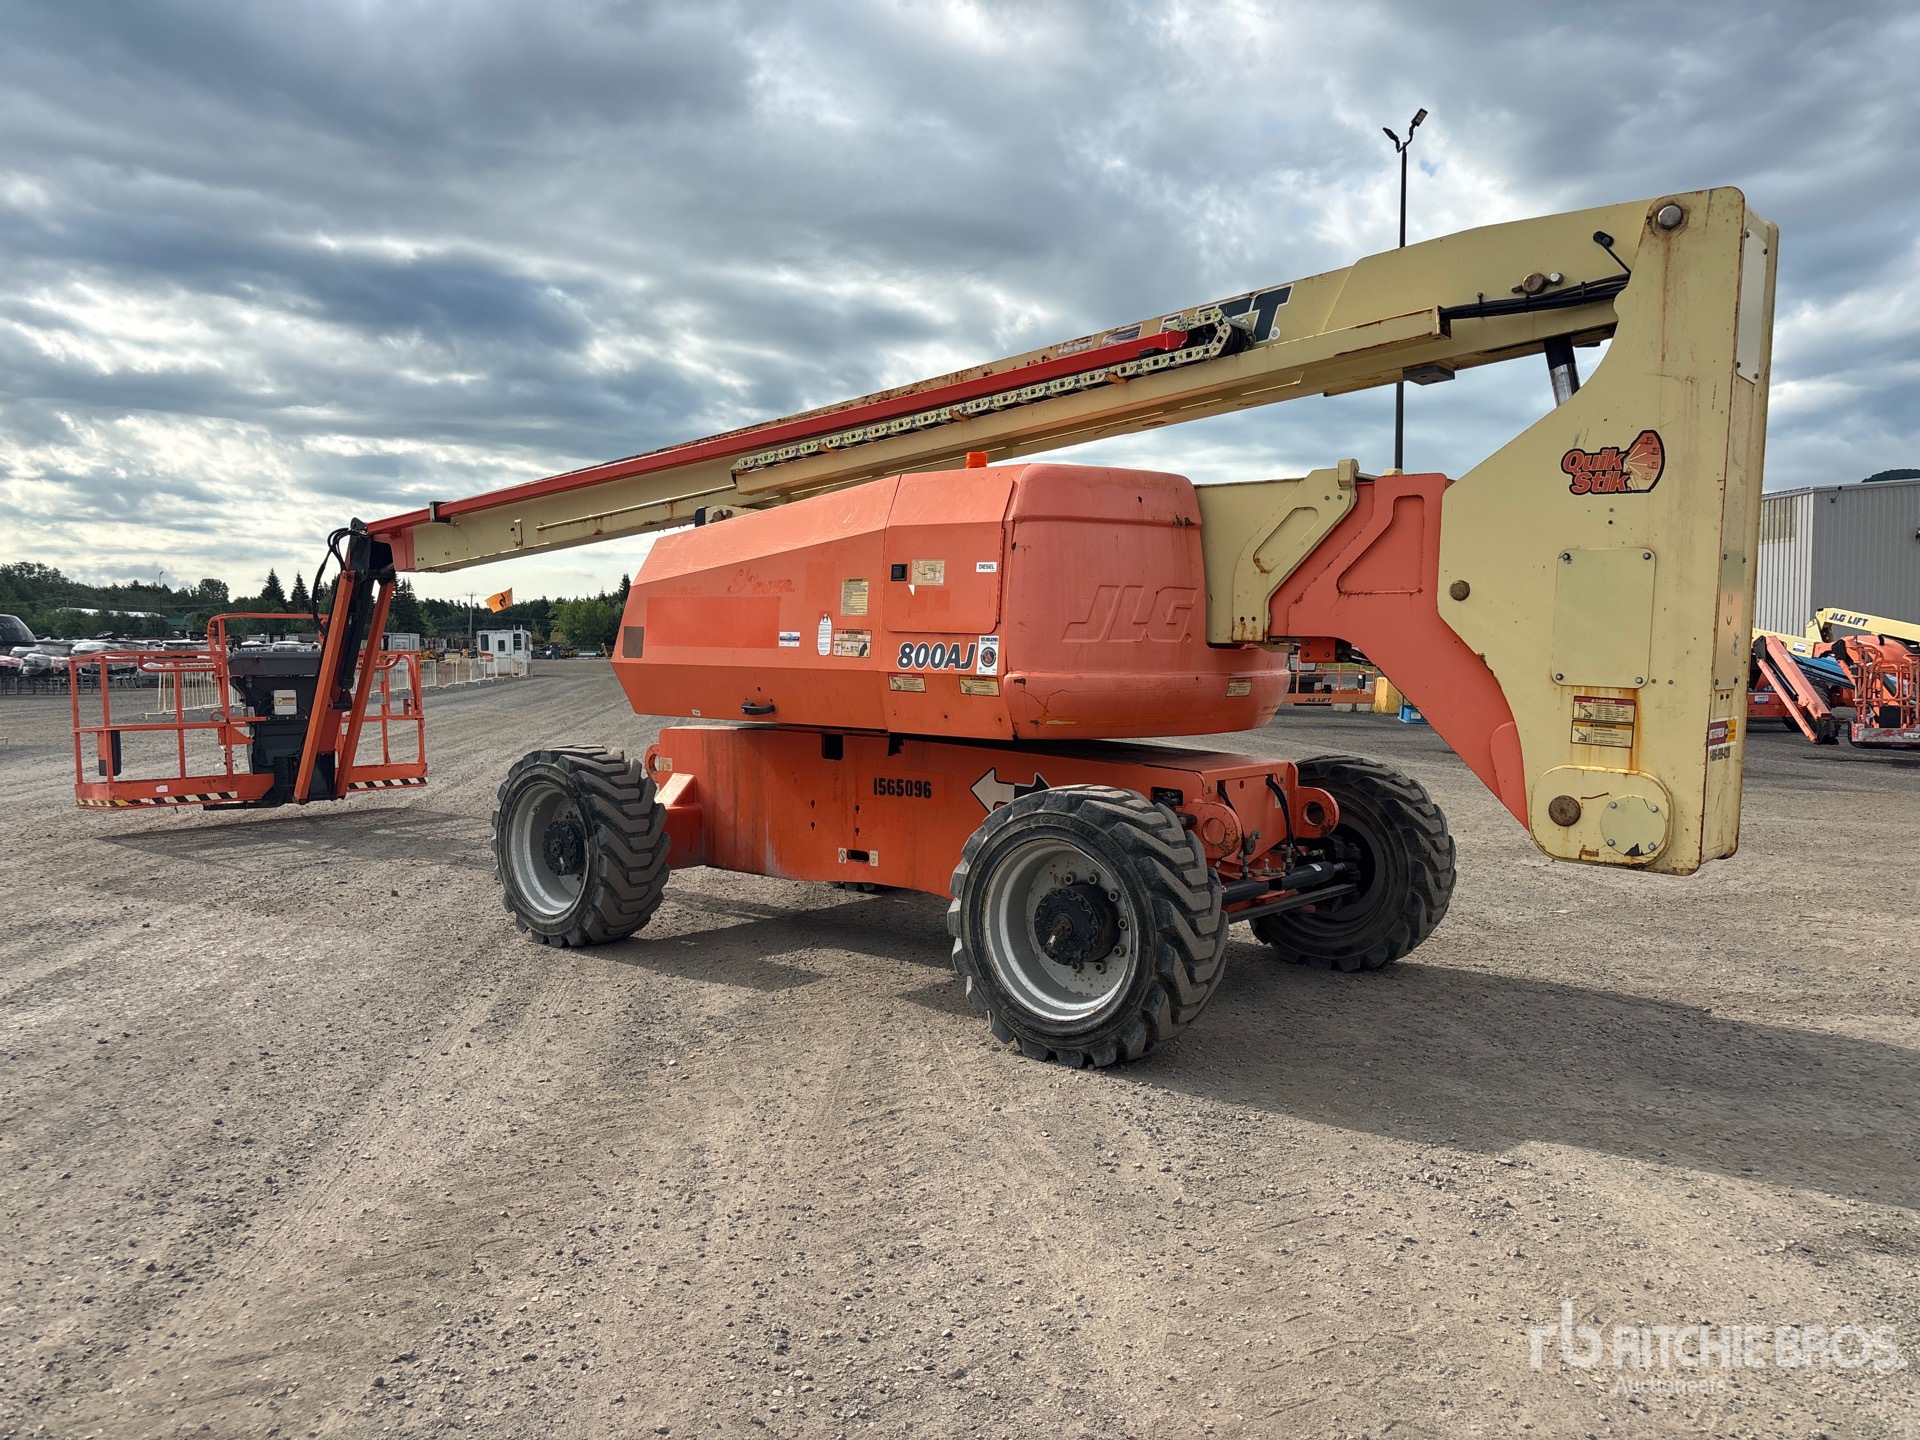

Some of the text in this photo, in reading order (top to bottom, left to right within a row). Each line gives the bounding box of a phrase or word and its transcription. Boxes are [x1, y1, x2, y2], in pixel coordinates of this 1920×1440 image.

[1562, 448, 1625, 474] Quik
[1571, 471, 1630, 493] Stik
[1062, 584, 1198, 642] JLG
[1829, 612, 1869, 627] JLG LIFT
[897, 642, 976, 670] 800AJ
[873, 777, 932, 799] 1565096
